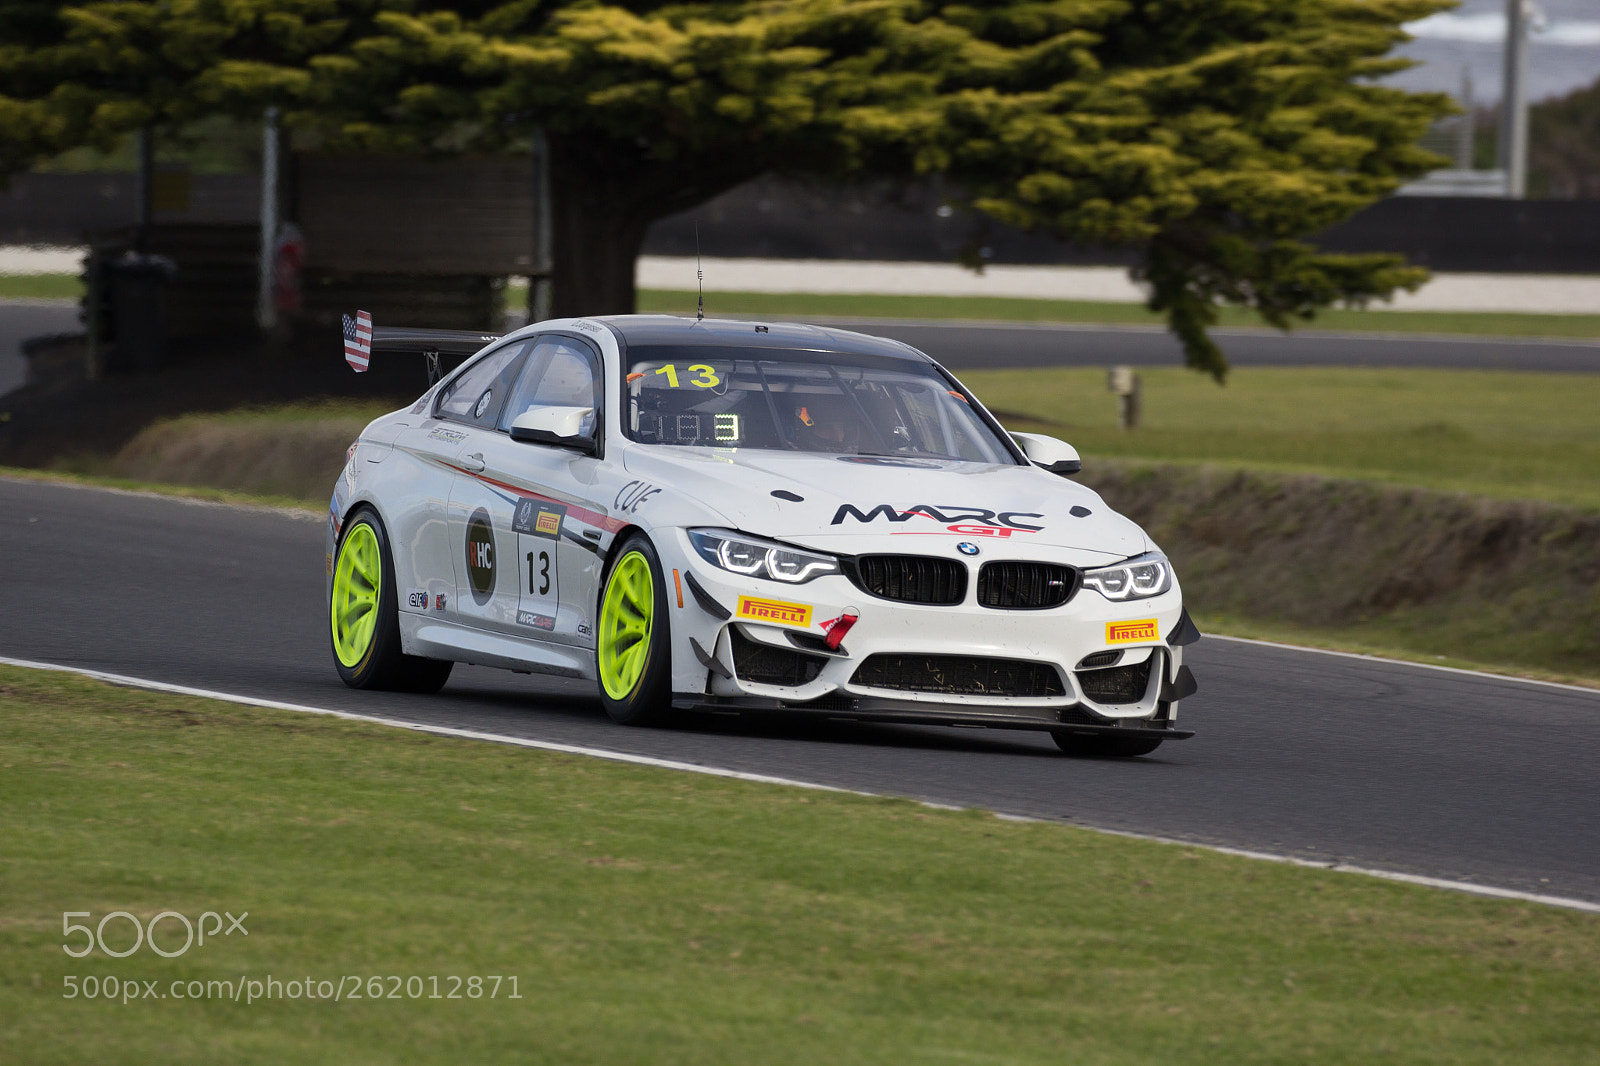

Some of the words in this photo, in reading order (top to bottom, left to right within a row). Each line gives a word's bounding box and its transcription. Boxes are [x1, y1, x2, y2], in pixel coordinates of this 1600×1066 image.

[655, 364, 720, 388] 13
[537, 515, 559, 531] PIRELLI
[830, 503, 1046, 531] MARC
[946, 524, 1038, 539] GT
[470, 541, 492, 569] RHC
[526, 551, 550, 595] 13
[409, 592, 422, 608] elf
[742, 600, 806, 623] PIRELLI
[1109, 623, 1155, 640] PIRELLI
